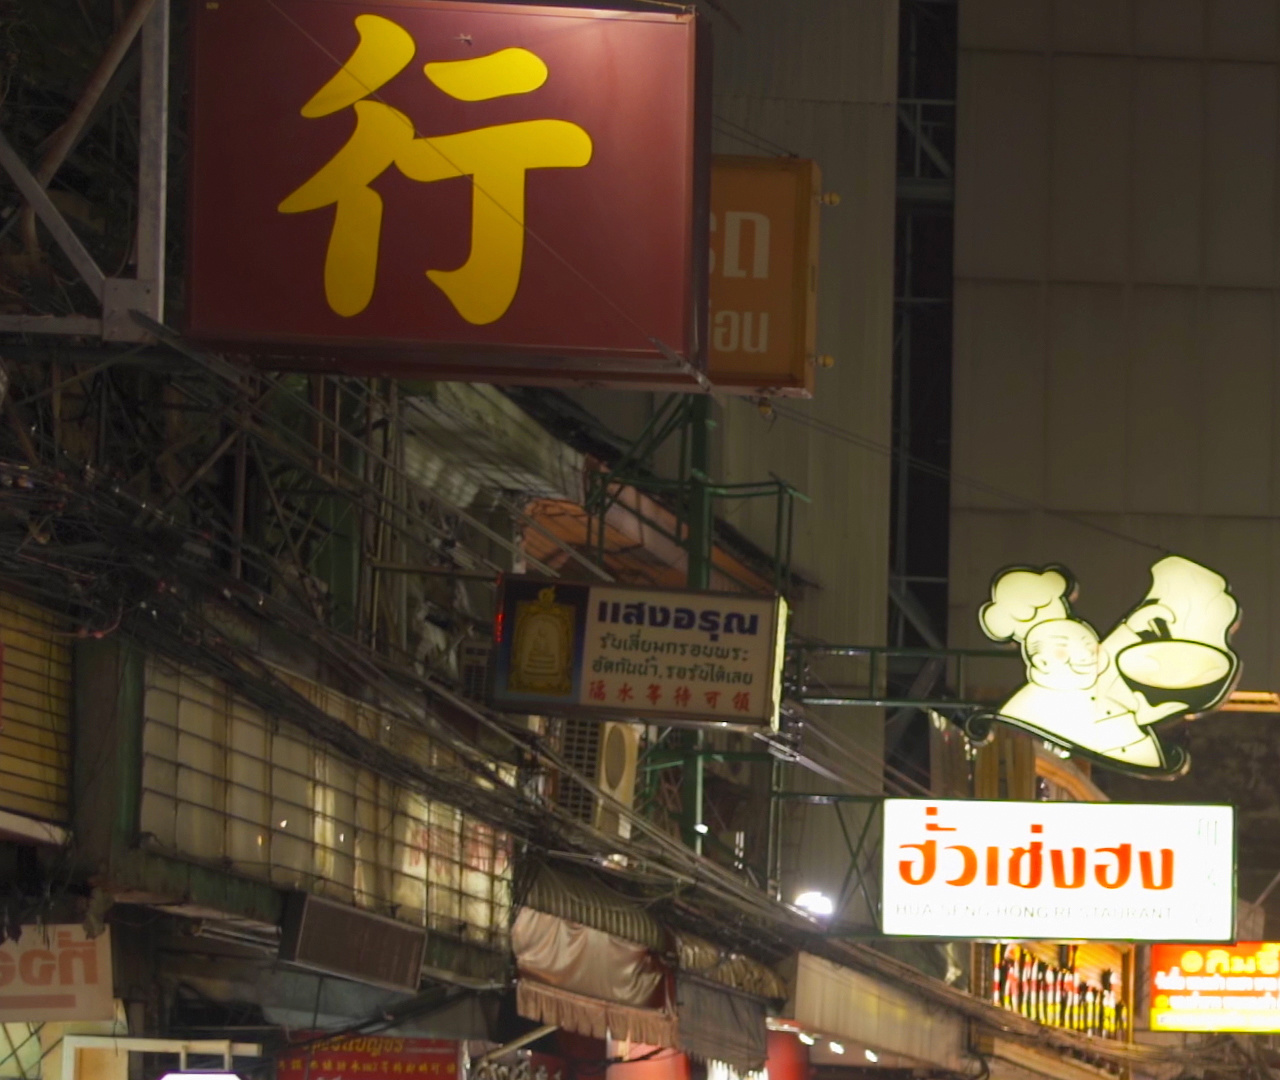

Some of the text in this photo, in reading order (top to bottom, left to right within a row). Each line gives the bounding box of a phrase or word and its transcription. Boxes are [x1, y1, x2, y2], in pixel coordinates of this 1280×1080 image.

[278, 13, 593, 326] 行
[598, 600, 759, 641] แสงอรุณ
[898, 806, 1174, 890] ฮั่วเซ่งฮง
[896, 902, 933, 916] HUA
[996, 905, 1050, 919] HONG
